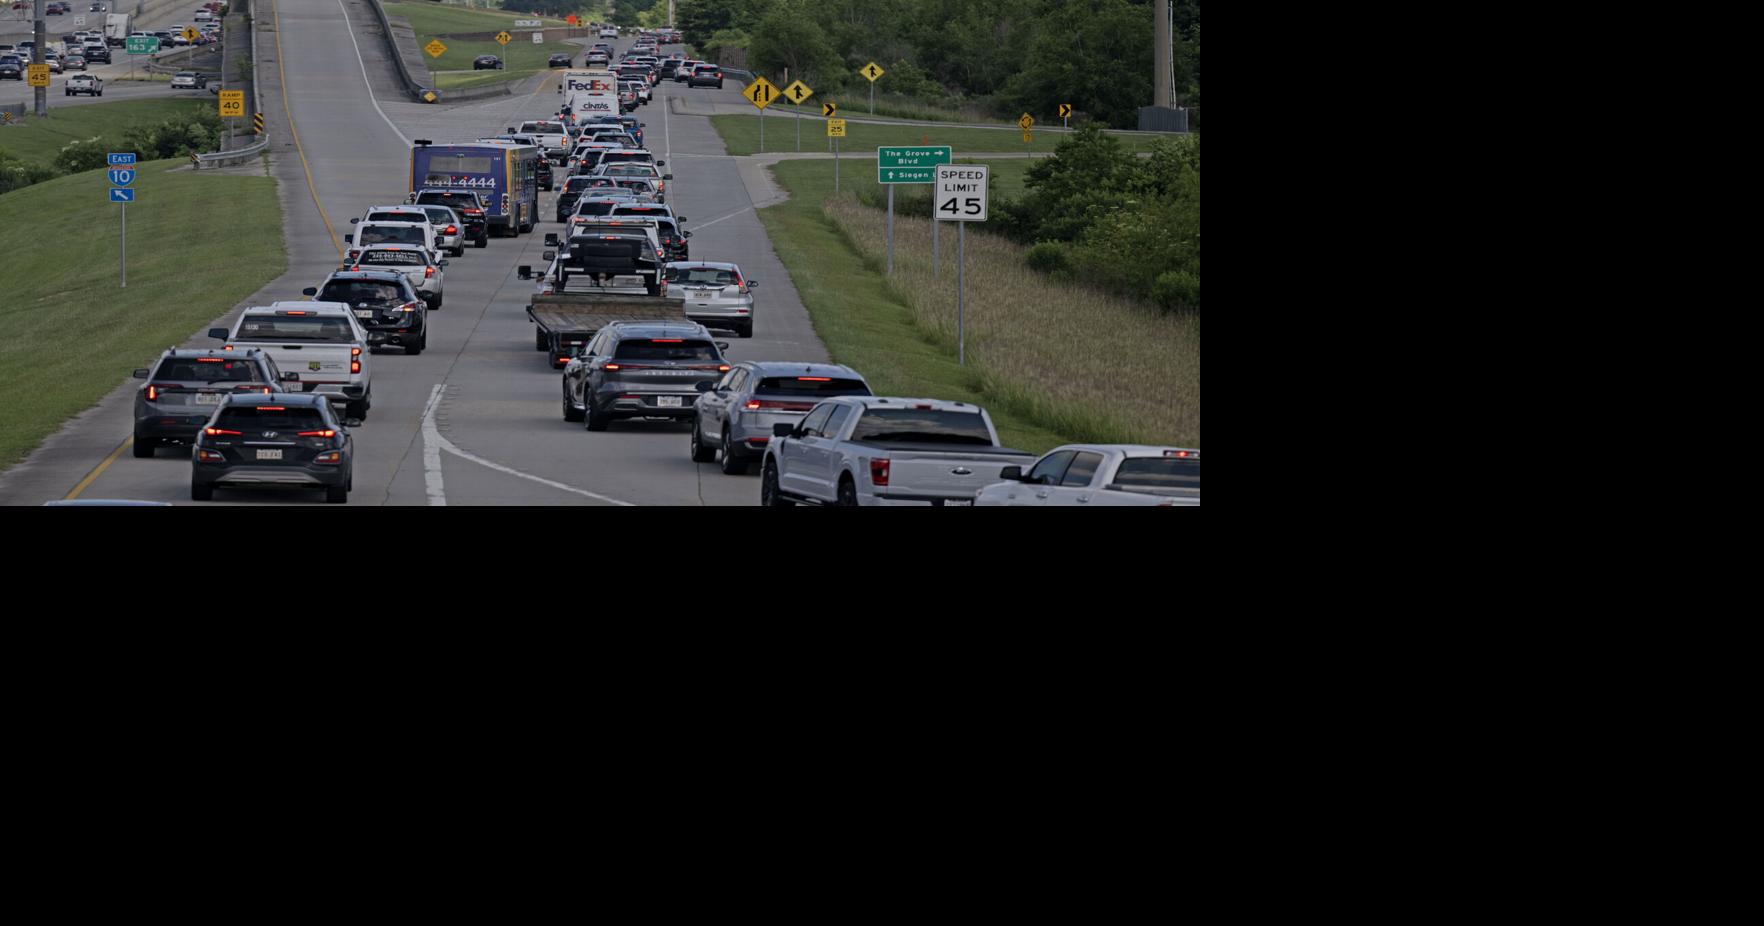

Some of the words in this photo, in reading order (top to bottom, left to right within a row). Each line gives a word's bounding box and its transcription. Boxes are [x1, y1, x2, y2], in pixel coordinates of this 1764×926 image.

[568, 80, 609, 90] FedEx
[112, 155, 133, 163] EAST
[113, 170, 130, 183] 10
[941, 170, 984, 180] SPEED
[944, 183, 979, 192] LIMIT
[940, 197, 982, 215] 45
